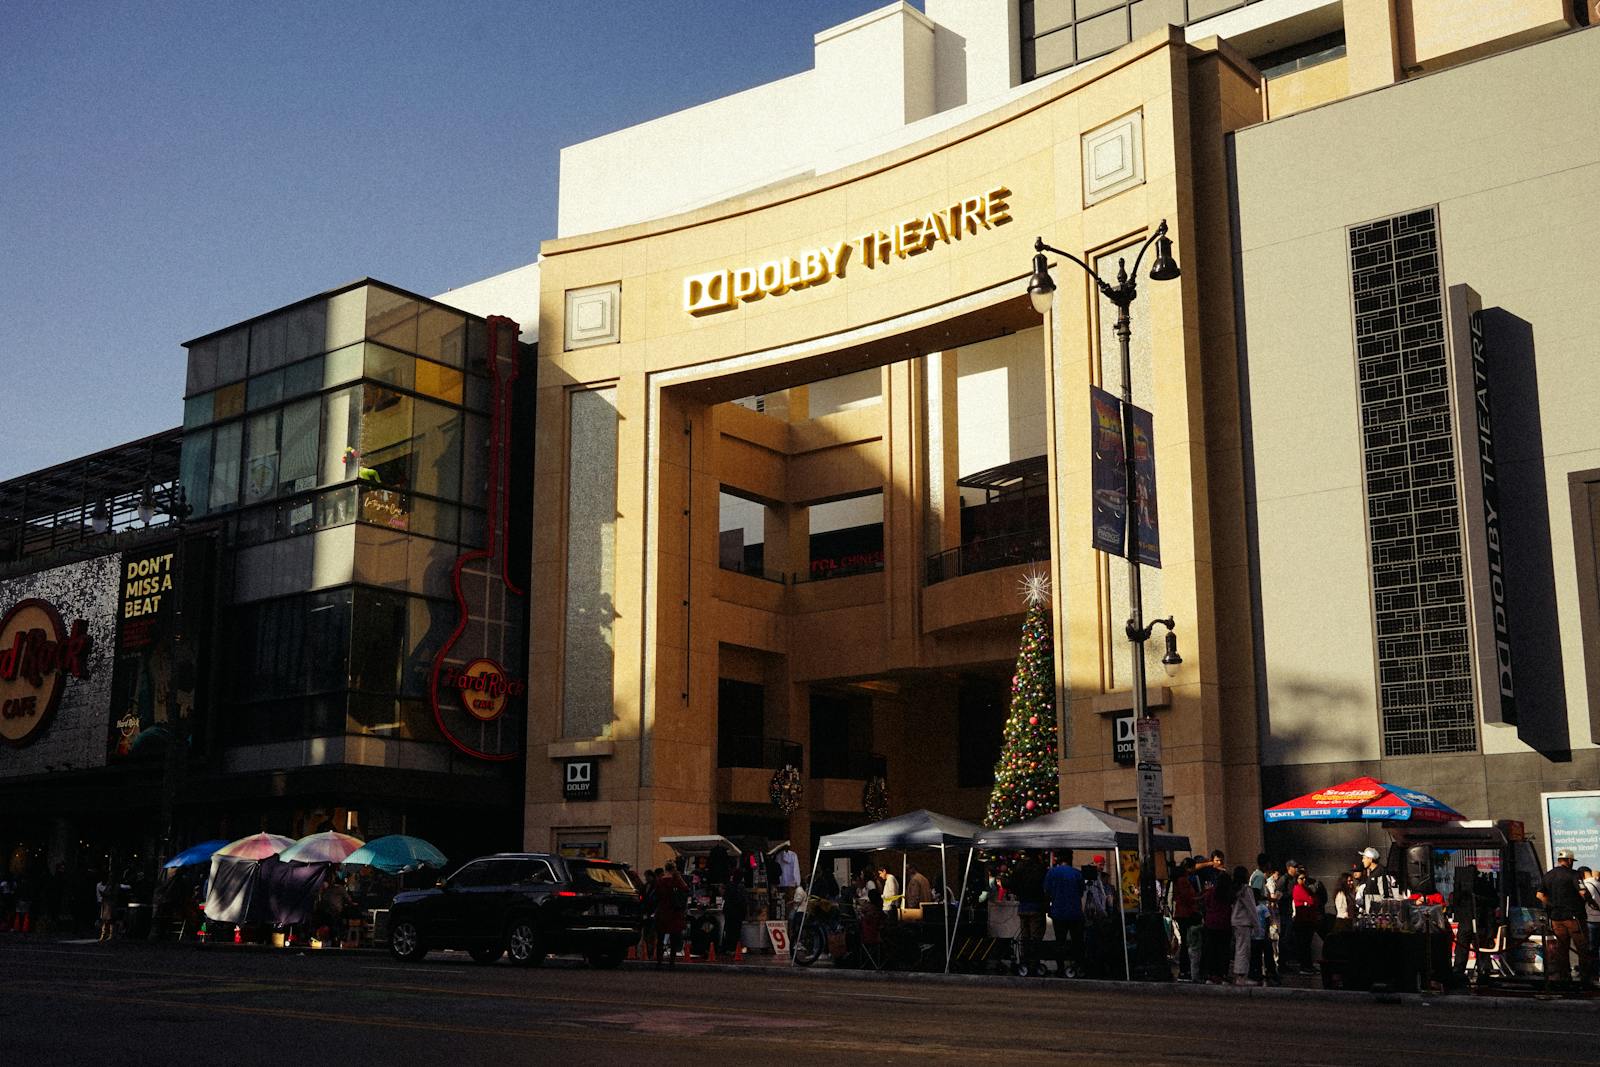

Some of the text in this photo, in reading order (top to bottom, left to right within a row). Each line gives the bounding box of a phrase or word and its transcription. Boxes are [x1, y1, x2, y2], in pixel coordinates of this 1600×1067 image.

[734, 185, 1012, 303] DOLBY THEATRE
[1471, 313, 1508, 635] DOLBY THEATRE
[127, 553, 174, 580] DON'T
[125, 574, 173, 599] MISS A
[124, 595, 161, 619] BEAT
[1117, 743, 1135, 753] DOL
[567, 783, 590, 791] DOLBY
